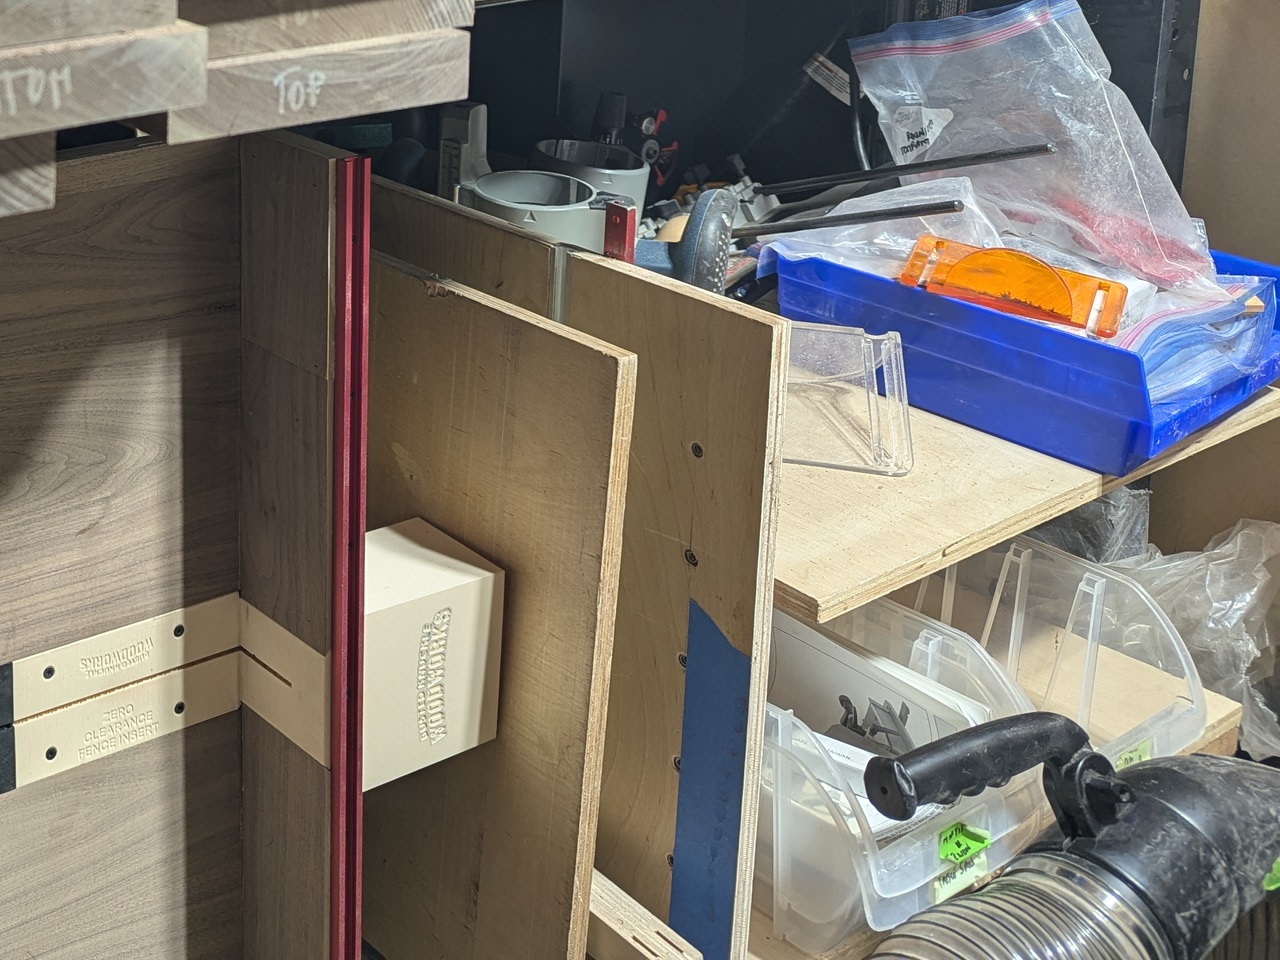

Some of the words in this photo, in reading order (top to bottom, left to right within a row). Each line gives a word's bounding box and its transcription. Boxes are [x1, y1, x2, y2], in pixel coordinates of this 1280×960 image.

[272, 65, 327, 115] TOP
[426, 606, 452, 745] WOODWORKS
[84, 710, 154, 744] CLEARANCE
[102, 703, 135, 724] ZERO
[78, 737, 117, 760] FENCE
[119, 722, 160, 747] INSERT
